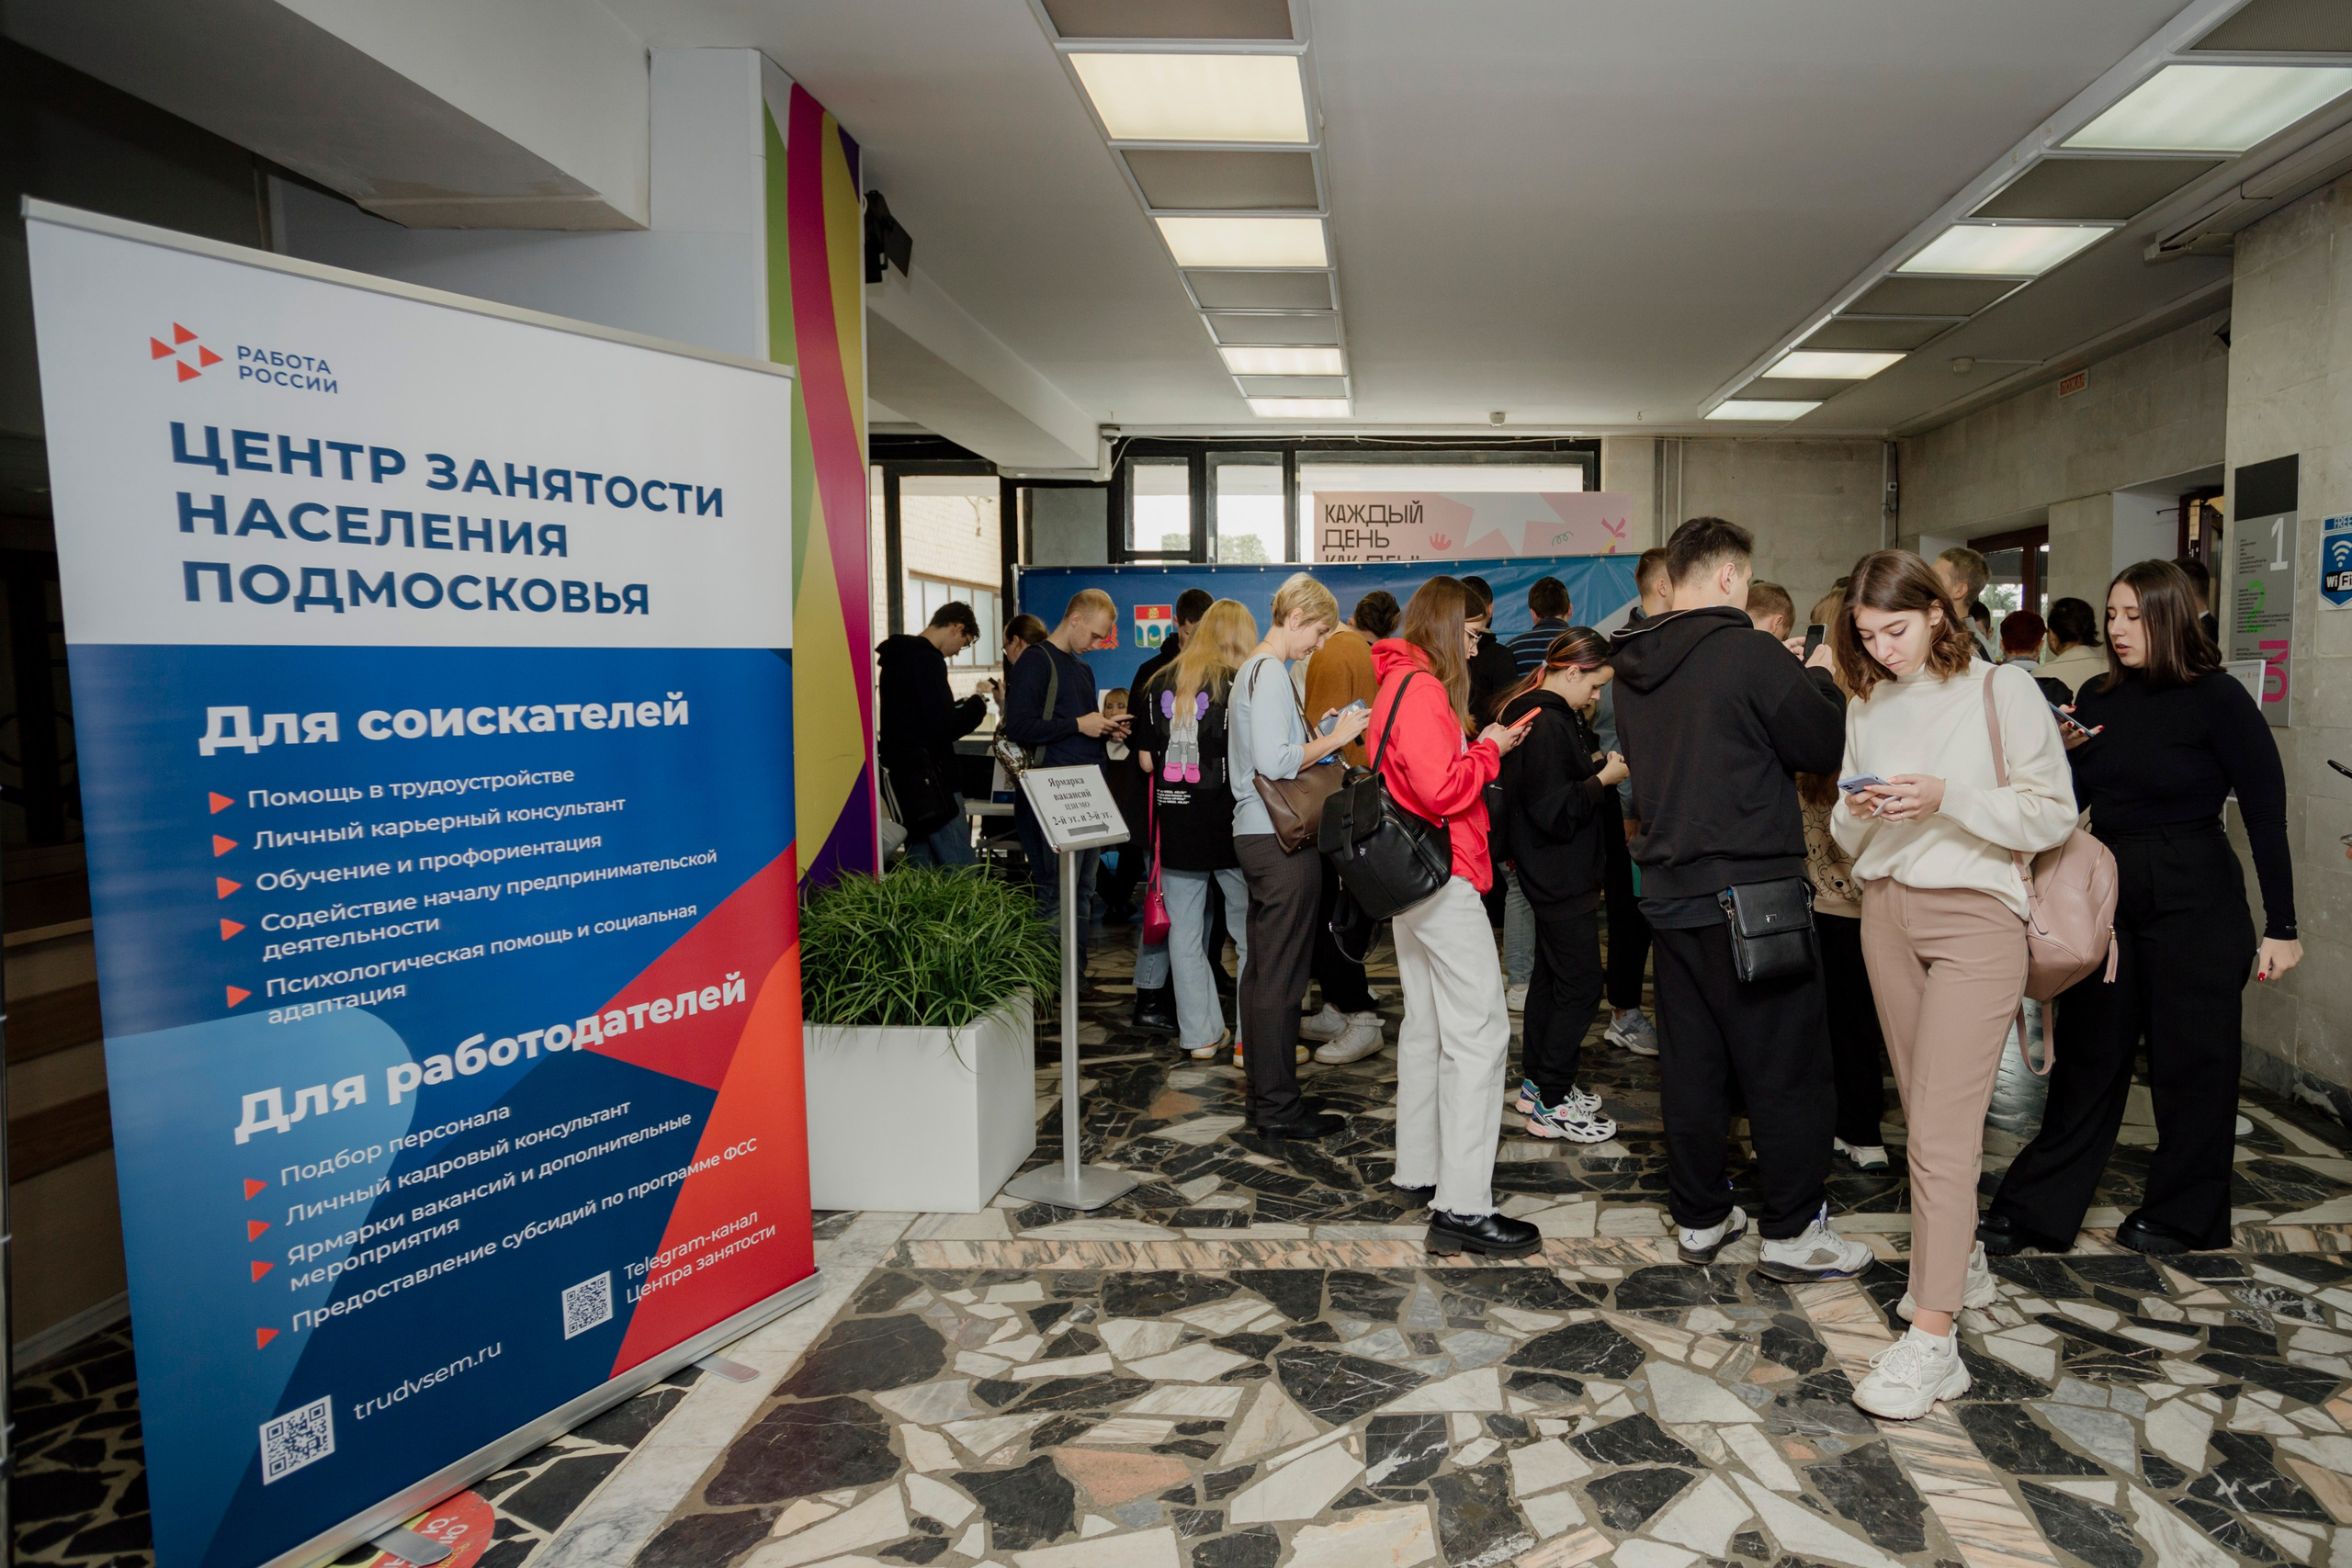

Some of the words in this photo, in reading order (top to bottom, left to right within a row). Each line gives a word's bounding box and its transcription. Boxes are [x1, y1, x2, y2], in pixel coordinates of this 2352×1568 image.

[237, 345, 332, 375] РАБОТА
[239, 365, 338, 394] РОССИИ
[169, 421, 406, 484] ЦЕНТР
[424, 453, 724, 517] ЗАНЯТОСТИ
[176, 491, 568, 558] НАСЕЛЕНИЯ
[1322, 529, 1390, 552] ДЕНЬ
[1325, 500, 1423, 527] КАЖДЫЙ
[2334, 515, 2352, 529] FREE
[2269, 517, 2288, 571] 1
[182, 560, 650, 615] ПОДМОСКОВЬЯ
[2246, 580, 2266, 633] 2
[198, 705, 340, 757] Для
[357, 691, 689, 741] соискателей
[248, 786, 363, 808] Помощь
[369, 784, 383, 798] в
[389, 770, 575, 799] трудоустройстве
[1048, 777, 1085, 789] Ярмарка
[1053, 788, 1091, 801] вакансий
[1080, 801, 1091, 809] МО
[253, 821, 364, 850] Личный
[371, 808, 501, 839] карьерный
[507, 798, 627, 822] консультант
[1052, 815, 1067, 826] 2-й
[1087, 810, 1101, 820] 3-й
[256, 862, 390, 891] Обучение
[397, 859, 412, 873] и
[419, 835, 602, 873] профориентация
[261, 897, 417, 931] Содействие
[424, 884, 502, 908] началу
[507, 849, 718, 896] предпринимательской
[262, 918, 440, 963] деятельности
[266, 943, 485, 998] Психологическая
[491, 928, 572, 954] помощь
[577, 925, 590, 938] и
[594, 905, 697, 934] социальная
[268, 984, 407, 1024] адаптация
[234, 1074, 367, 1145] Для
[386, 972, 747, 1106] работодателей
[281, 1145, 382, 1186] Подбор
[389, 1106, 512, 1153] персонала
[285, 1177, 391, 1226] Личный
[398, 1139, 509, 1189] кадровый
[514, 1101, 631, 1151] консультант
[288, 1213, 405, 1266] Ярмарки
[412, 1172, 515, 1222] вакансий
[521, 1168, 535, 1184] и
[538, 1113, 692, 1179] дополнительные
[290, 1218, 460, 1292] мероприятия
[292, 1242, 498, 1332] Предоставление
[502, 1200, 597, 1249] субсидий
[601, 1191, 624, 1211] по
[628, 1155, 720, 1200] программе
[723, 1137, 757, 1161] ФСС
[623, 1211, 758, 1280] Telegram-канал
[627, 1265, 693, 1304] Центра
[695, 1224, 776, 1272] занятости
[353, 1341, 502, 1420] trudvsem.ru
